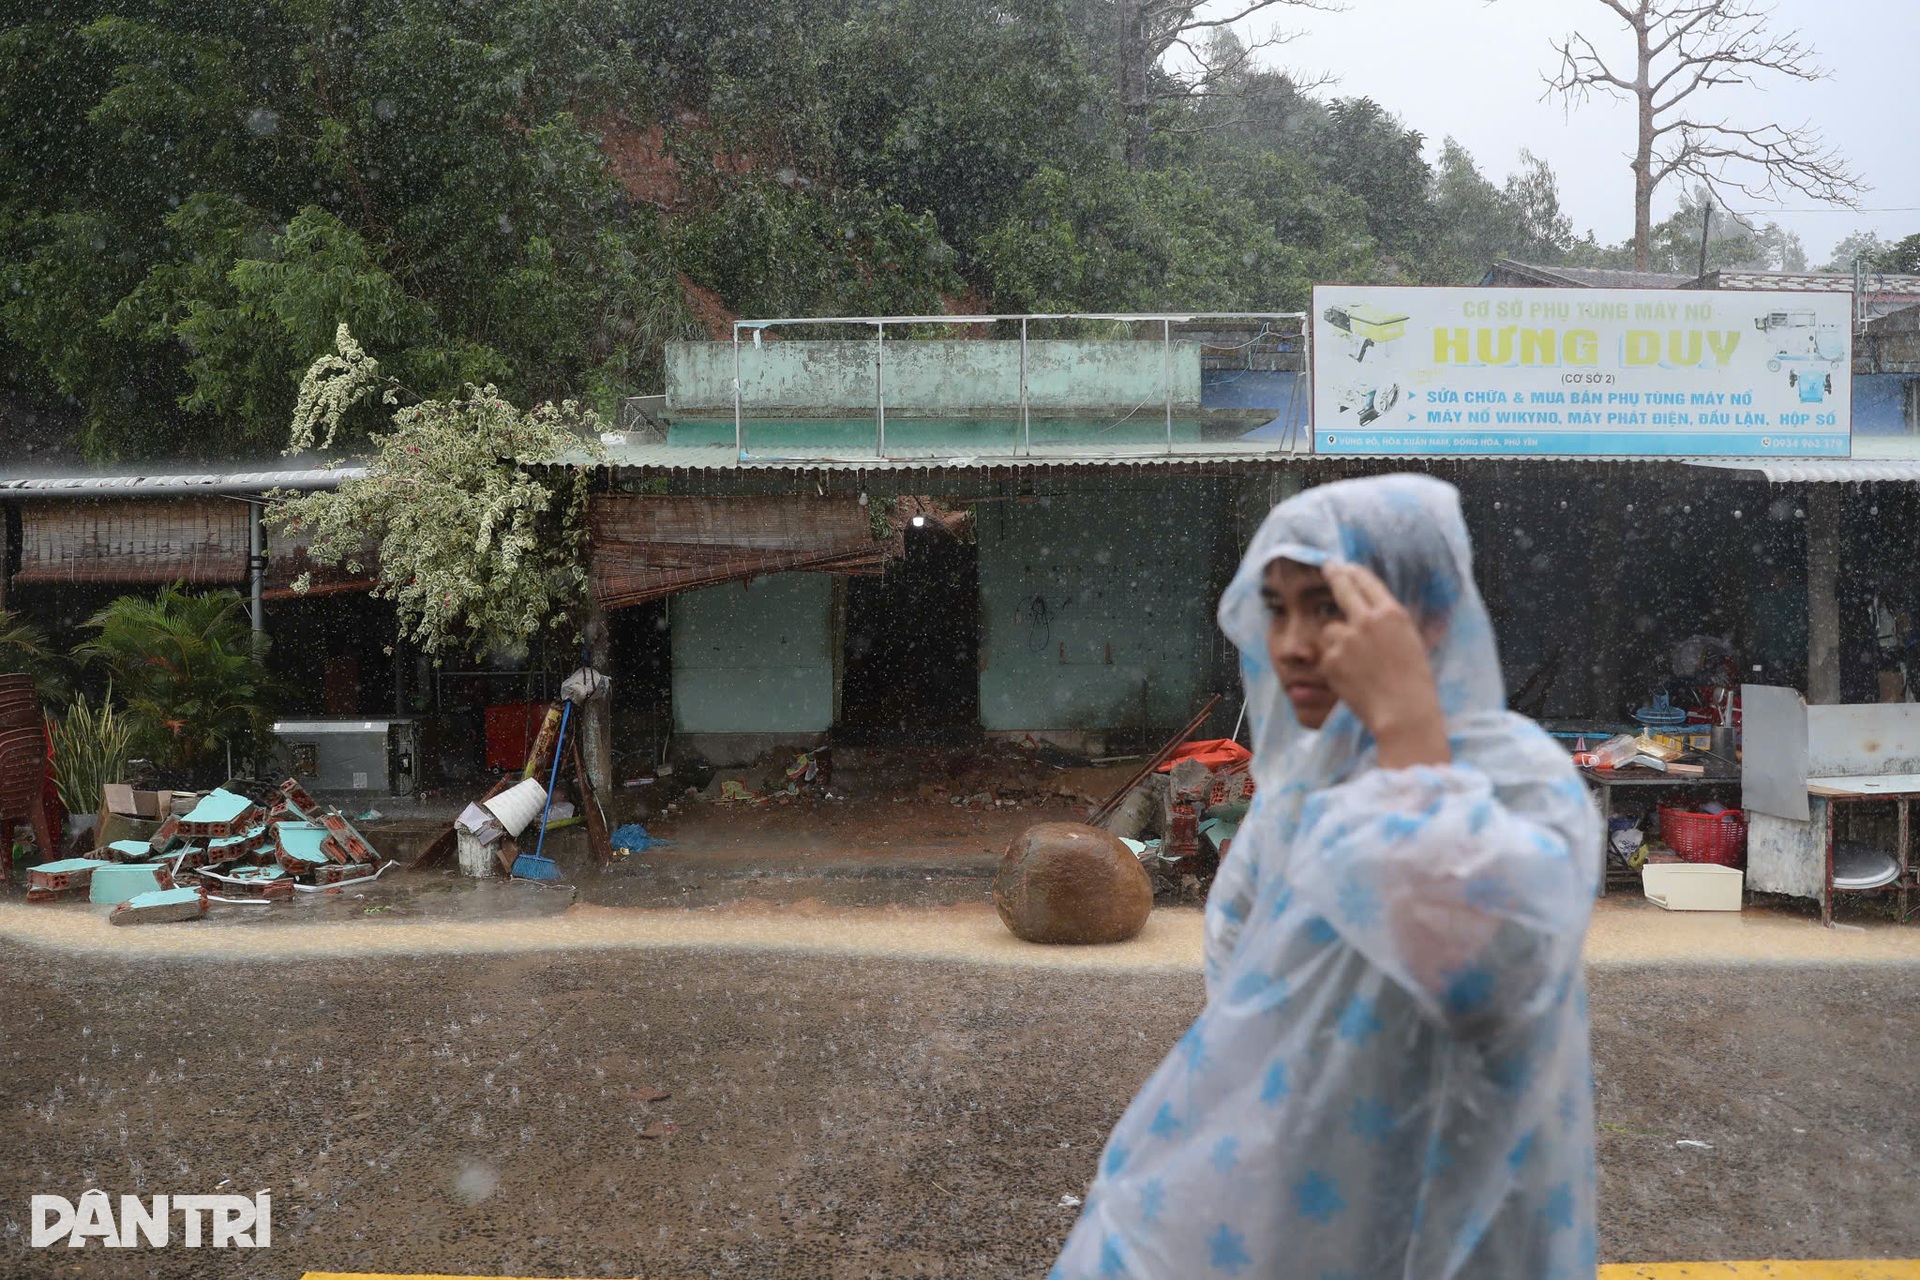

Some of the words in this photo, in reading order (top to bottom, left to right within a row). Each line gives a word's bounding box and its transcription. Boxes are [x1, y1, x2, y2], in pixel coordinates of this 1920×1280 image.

[1463, 300, 1489, 318] CƠ
[1496, 296, 1523, 319] SỞ
[1530, 301, 1569, 321] PHỤ
[1434, 325, 1599, 366] HƯNG
[1624, 329, 1741, 367] DUY
[1561, 374, 1583, 386] (CƠ
[1586, 372, 1603, 384] SỞ
[1605, 374, 1616, 386] 2)
[1427, 387, 1459, 403] SỬA
[1464, 389, 1507, 404] CHỮA
[1513, 392, 1524, 404] &
[1531, 392, 1565, 405] MUA
[1570, 390, 1603, 405] BÁN
[1608, 392, 1640, 407] PHỤ
[1644, 391, 1686, 406] TÙNG
[1690, 391, 1725, 406] MÁY
[1427, 409, 1462, 423] MÁY
[1496, 411, 1562, 425] WIKYNO,
[1567, 410, 1602, 425] MÁY
[1607, 410, 1648, 426] PHÁT
[1652, 410, 1694, 427] ĐIỆN,
[1780, 411, 1810, 428] HỘP
